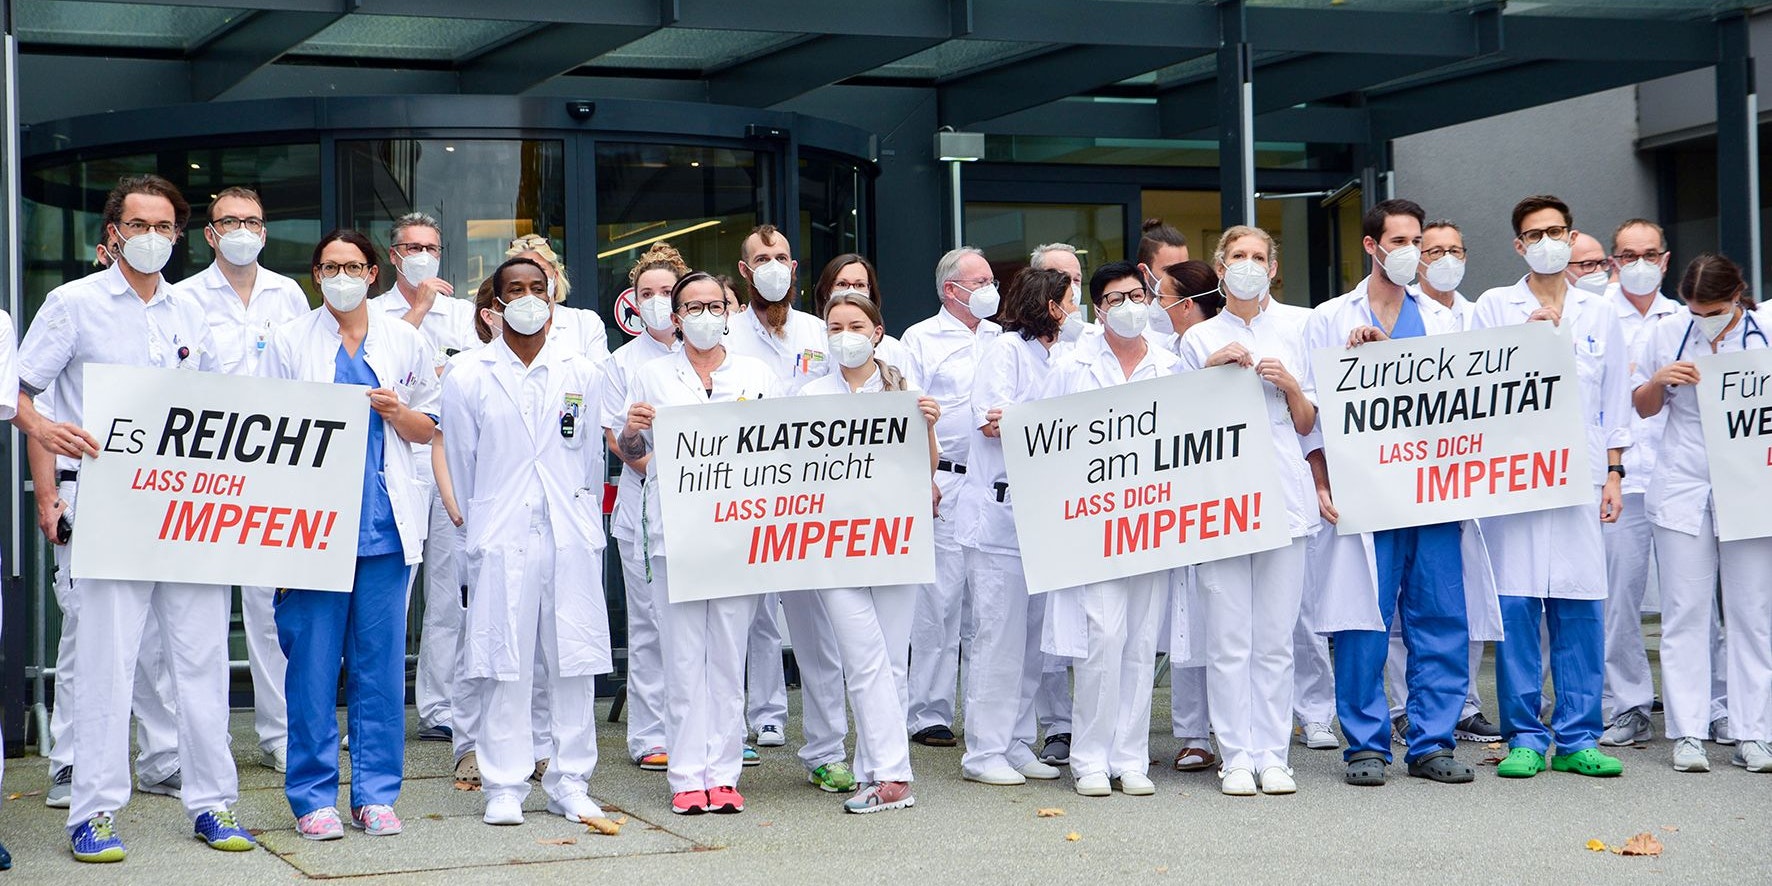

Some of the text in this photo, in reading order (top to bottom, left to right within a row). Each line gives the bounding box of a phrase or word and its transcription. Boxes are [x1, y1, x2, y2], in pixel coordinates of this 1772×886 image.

[1335, 345, 1519, 393] Zurück zur
[1721, 370, 1771, 401] Für
[1343, 370, 1561, 435] NORMALITÄT
[104, 406, 347, 468] Es REICHT
[675, 416, 909, 460] Nur KLATSCHEN
[1024, 400, 1157, 458] Wir sind
[1379, 433, 1483, 465] LASS DICH
[678, 452, 875, 493] hilft uns nicht
[1087, 423, 1247, 484] am LIMIT
[1416, 448, 1569, 504] IMPFEN!
[131, 468, 246, 497] LASS DICH
[1064, 482, 1171, 521] LASS DICH
[158, 499, 337, 551] IMPFEN!
[714, 493, 825, 523] LASS DICH
[1103, 491, 1262, 558] IMPFEN!
[747, 516, 914, 565] IMPFEN!
